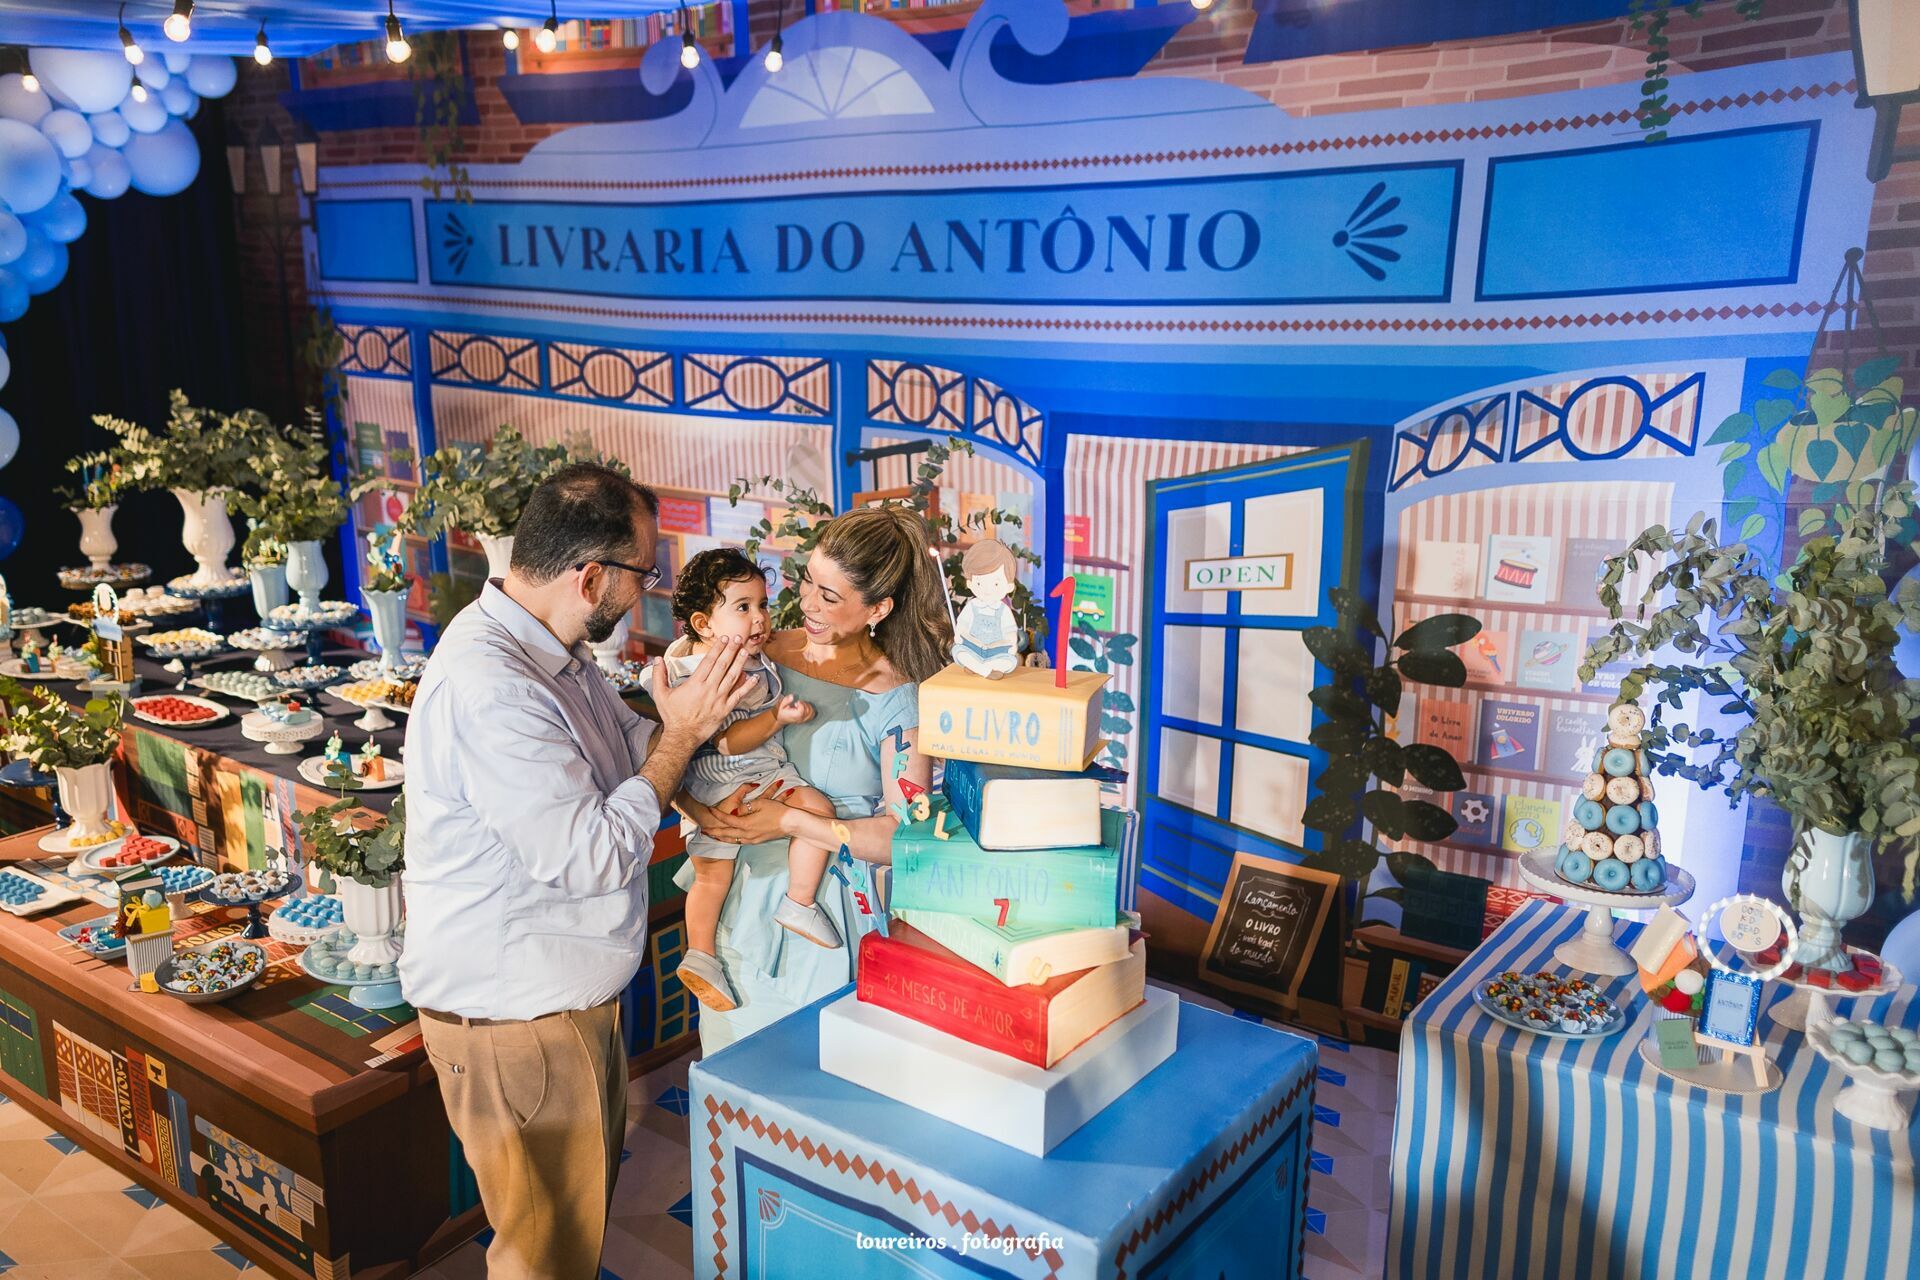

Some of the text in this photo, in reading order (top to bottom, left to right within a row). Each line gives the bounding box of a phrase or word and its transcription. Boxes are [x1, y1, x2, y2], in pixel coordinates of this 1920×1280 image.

[498, 204, 1261, 274] LIVRARIA DO ANTÔNIO
[1196, 565, 1276, 584] OPEN
[939, 707, 1040, 747] O LIVRO
[1243, 891, 1298, 916] Lançamento
[1245, 918, 1281, 936] O LIVRO
[884, 973, 1016, 1040] 12 MESES DE AMOR
[115, 1068, 134, 1130] CONTOS
